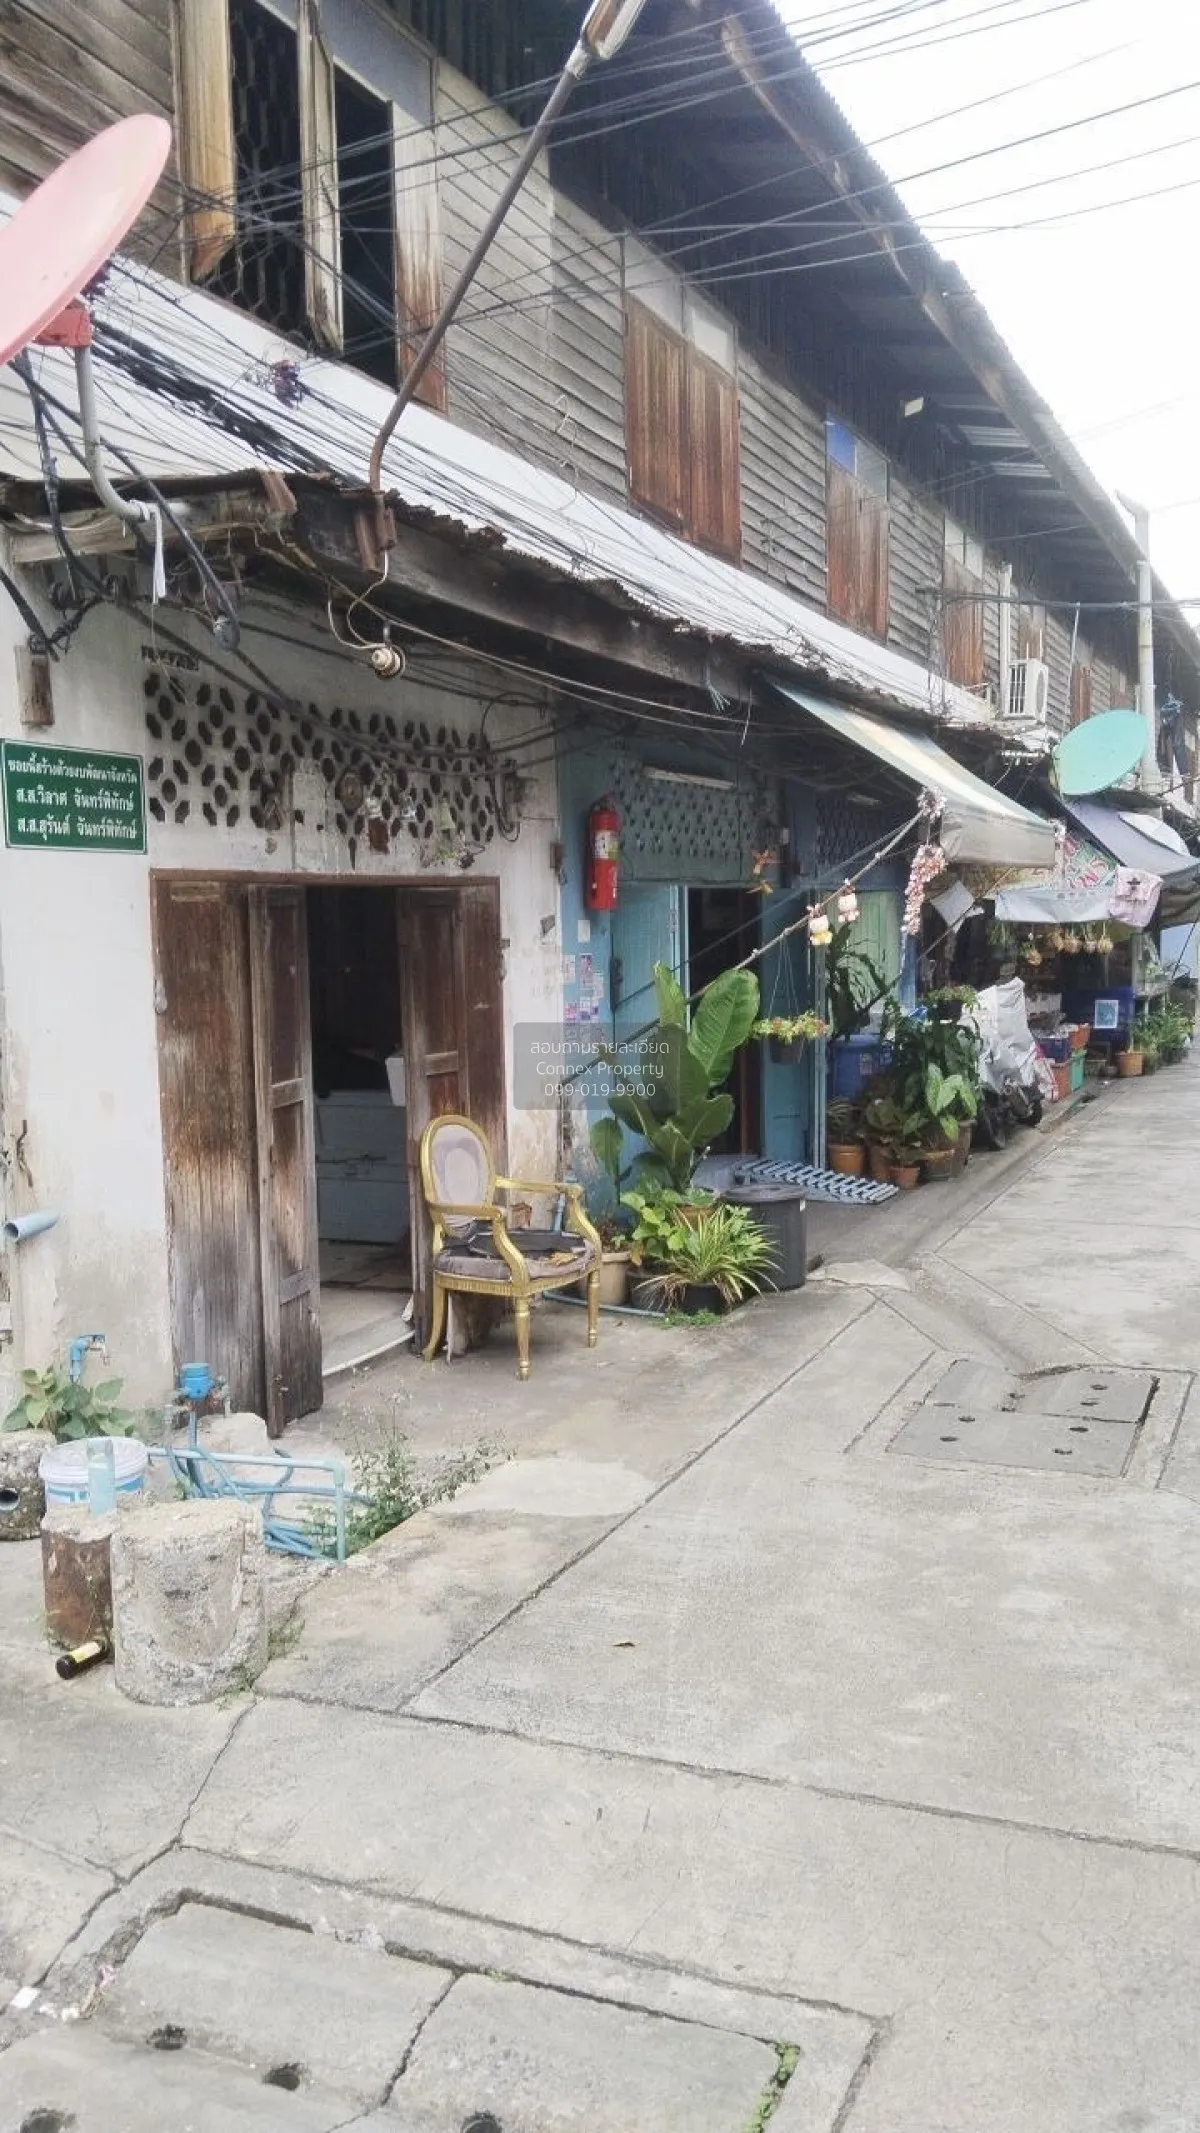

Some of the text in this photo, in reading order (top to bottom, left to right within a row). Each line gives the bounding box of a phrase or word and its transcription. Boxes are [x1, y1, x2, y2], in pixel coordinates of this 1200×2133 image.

[74, 787, 134, 811] จันทร์พิทักษ์
[77, 815, 138, 839] จันทร์พิทักษ์
